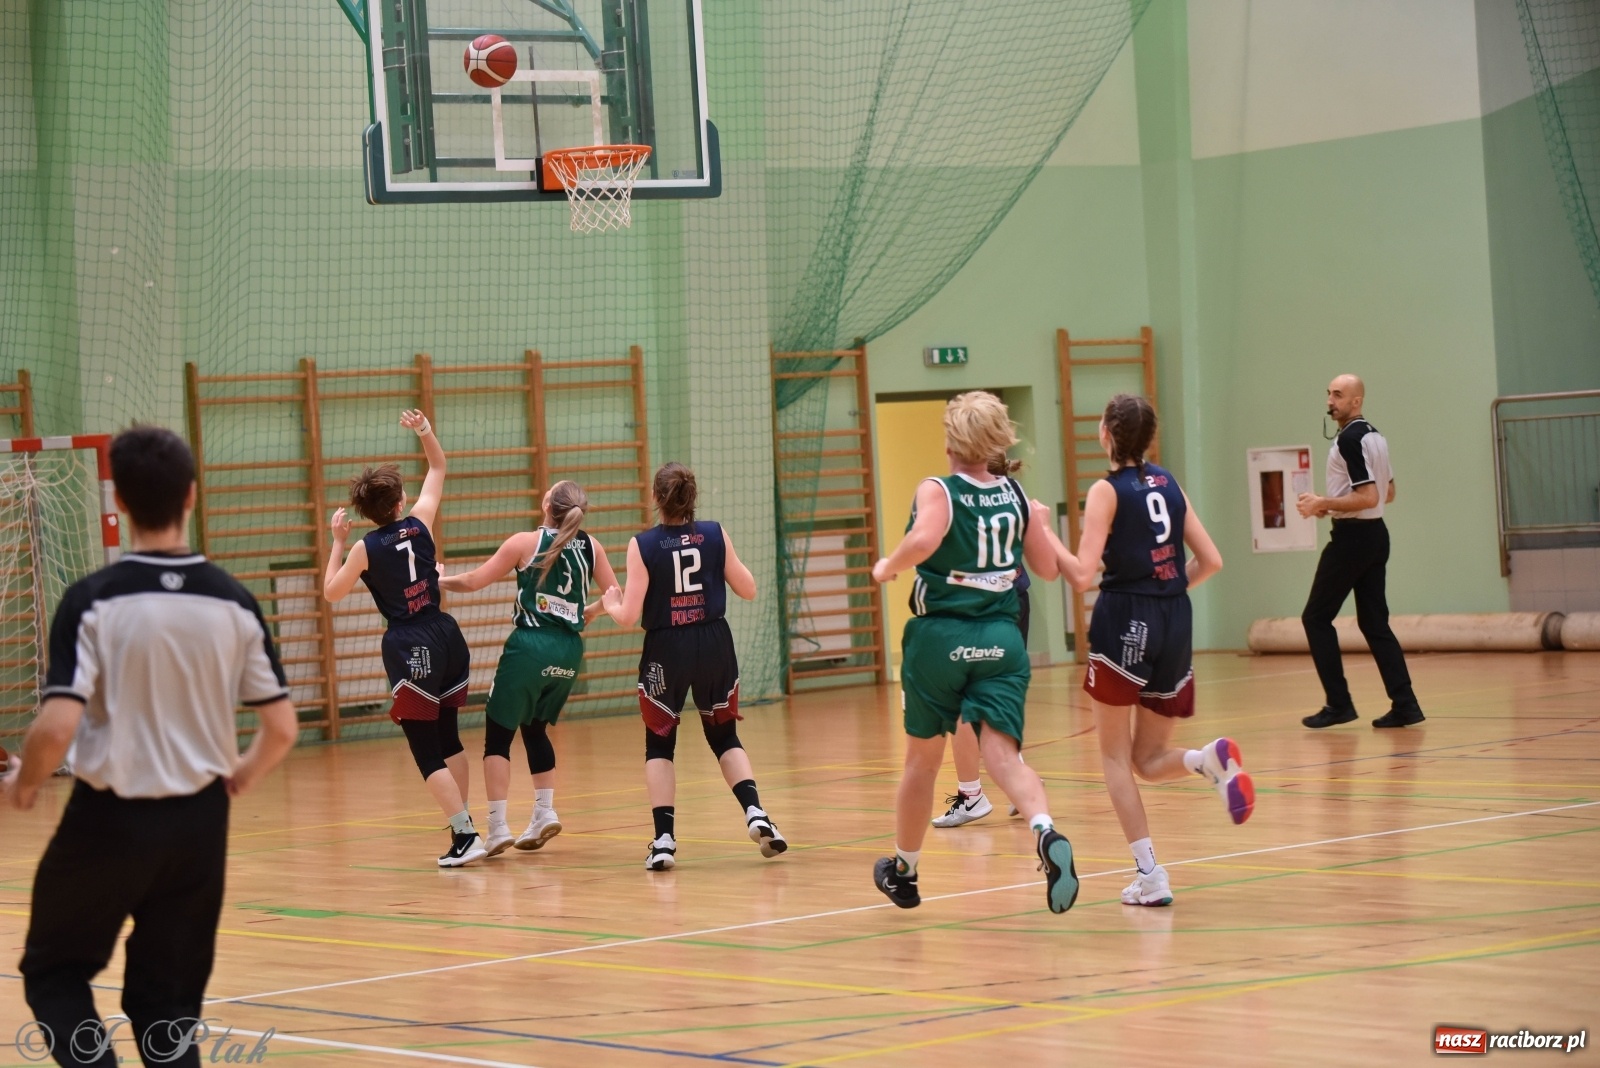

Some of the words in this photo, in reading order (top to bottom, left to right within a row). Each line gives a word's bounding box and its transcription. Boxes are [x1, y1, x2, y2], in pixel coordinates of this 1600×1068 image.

[1146, 492, 1171, 543] 9
[395, 540, 417, 582] 7
[977, 512, 1016, 568] 10
[672, 548, 703, 593] 12
[551, 666, 576, 677] Clavis
[963, 646, 1005, 659] Clavis
